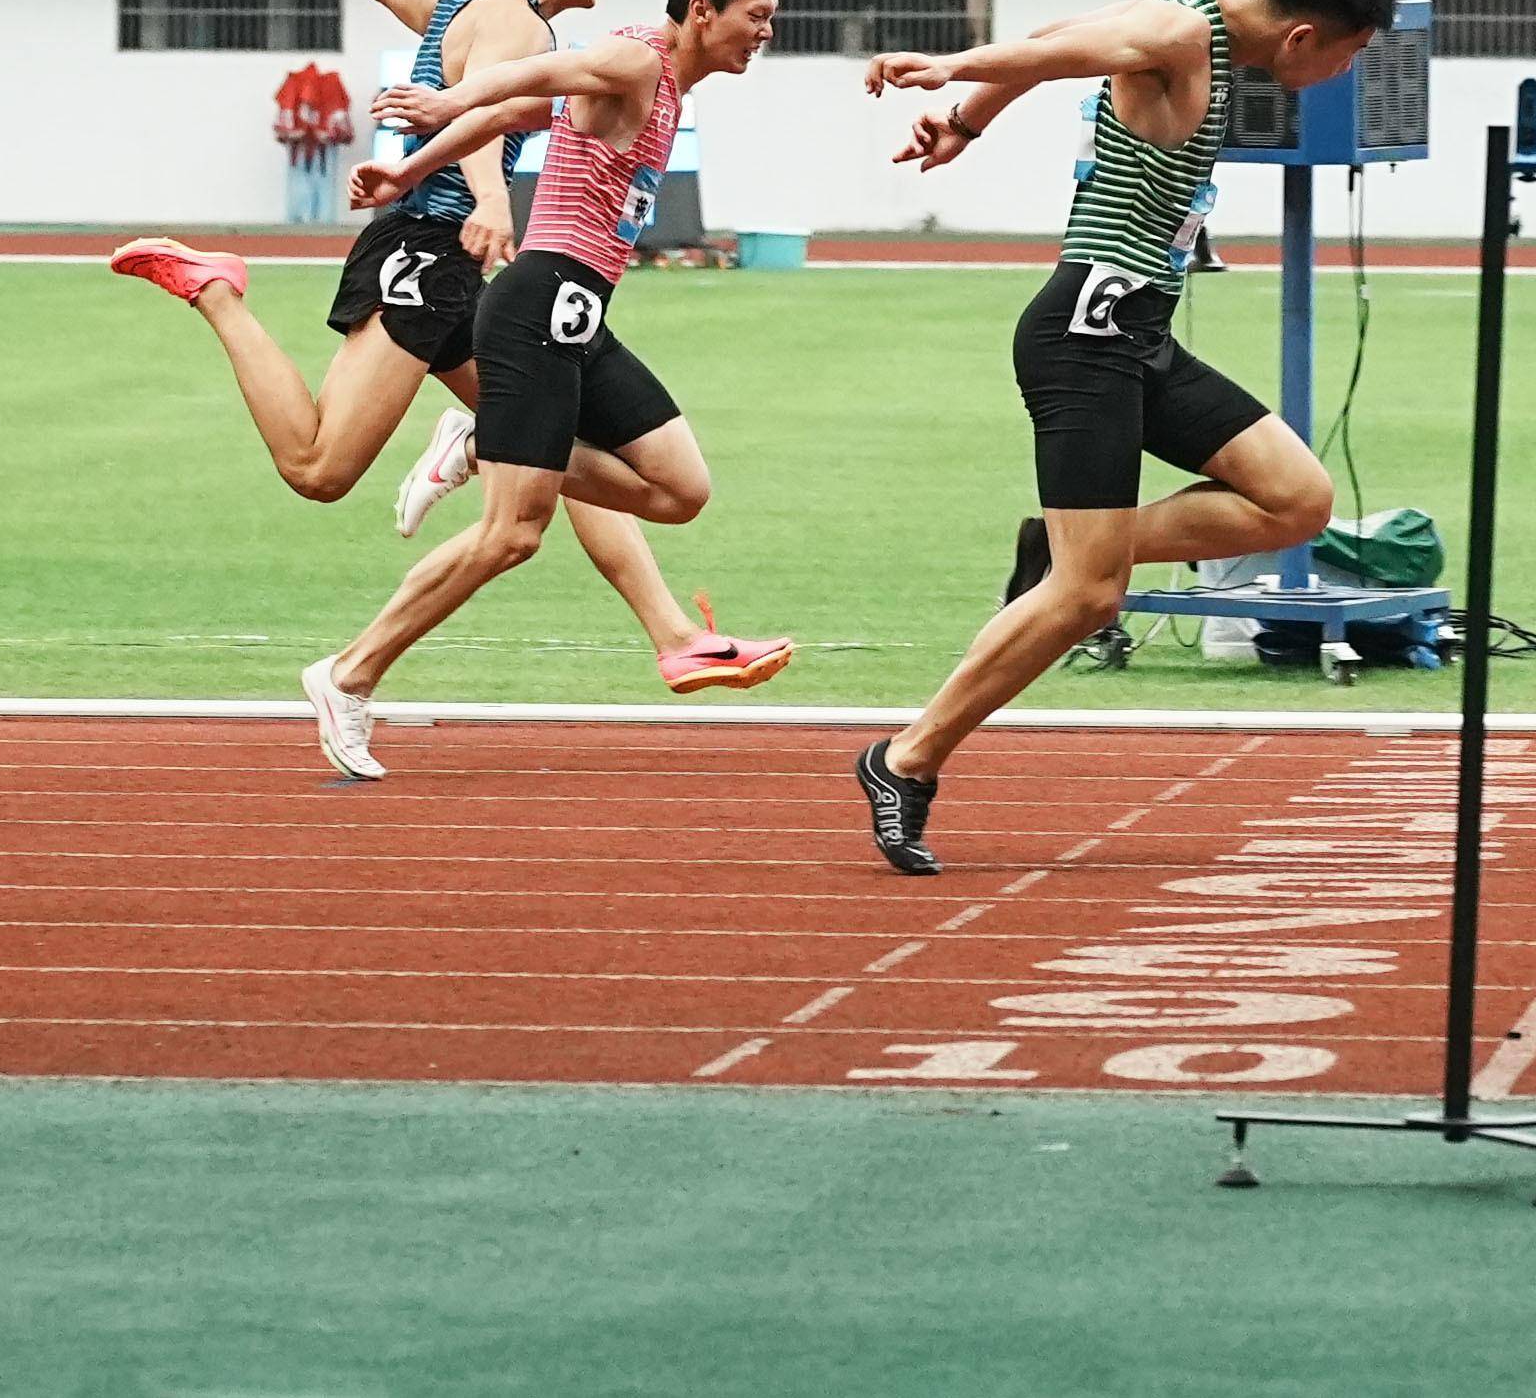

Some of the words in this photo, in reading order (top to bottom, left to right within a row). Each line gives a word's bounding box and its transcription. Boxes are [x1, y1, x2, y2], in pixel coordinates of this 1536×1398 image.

[387, 252, 422, 300] 2
[561, 291, 593, 338] 3
[1084, 275, 1134, 331] 6
[1116, 905, 1444, 934] 7
[1032, 943, 1400, 978] 8
[988, 989, 1356, 1028] 9
[845, 1040, 1339, 1083] 10
